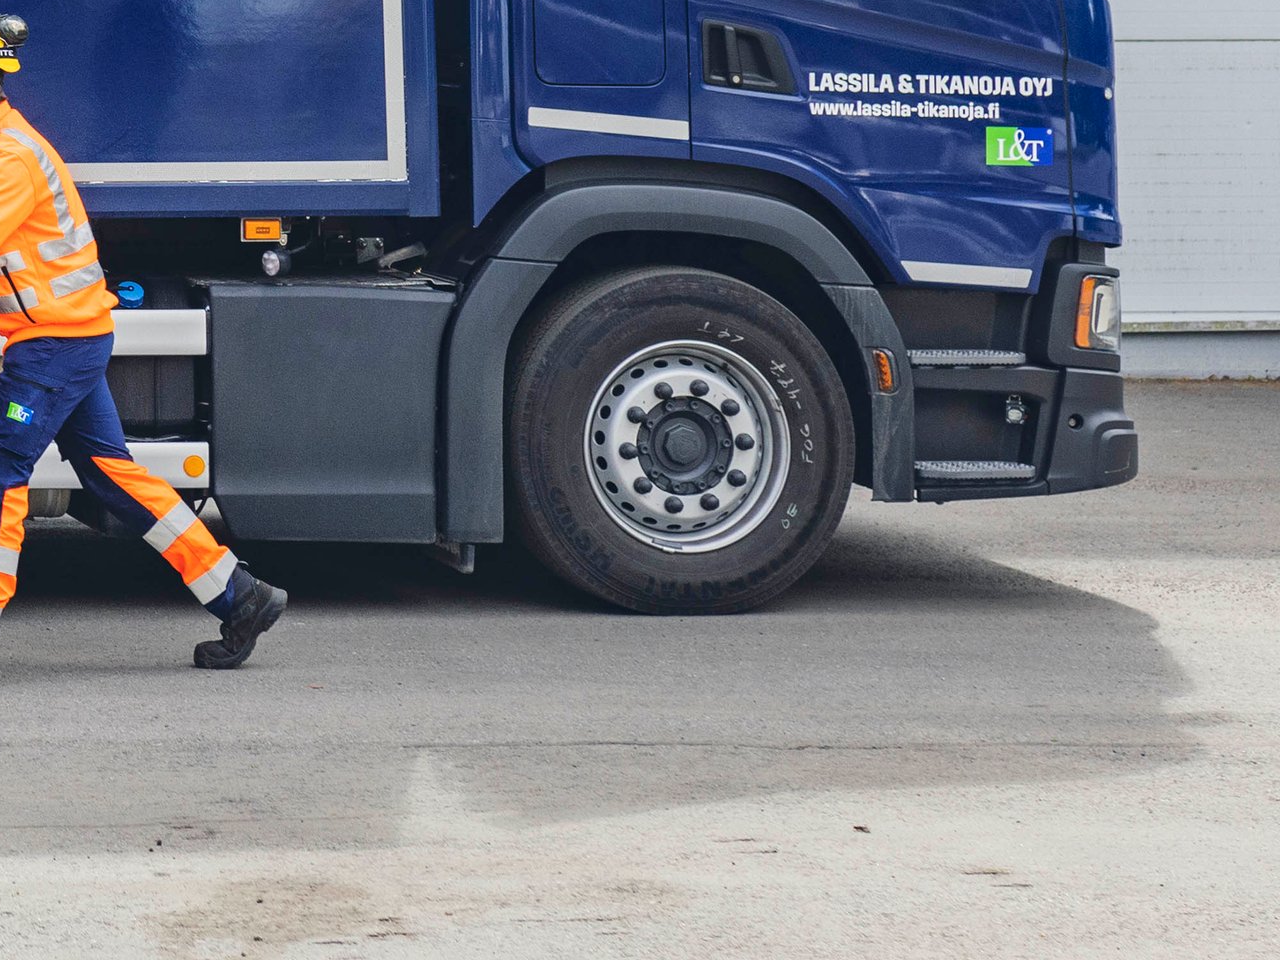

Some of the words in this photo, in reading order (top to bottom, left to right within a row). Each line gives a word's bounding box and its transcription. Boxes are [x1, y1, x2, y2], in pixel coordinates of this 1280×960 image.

[808, 72, 894, 93] LASSILA
[897, 73, 914, 95] &
[915, 74, 1015, 96] TIKANOJA
[1019, 77, 1054, 97] OYJ
[809, 100, 1000, 122] www.lassila-tikanoja.fi
[996, 129, 1045, 162] L&T
